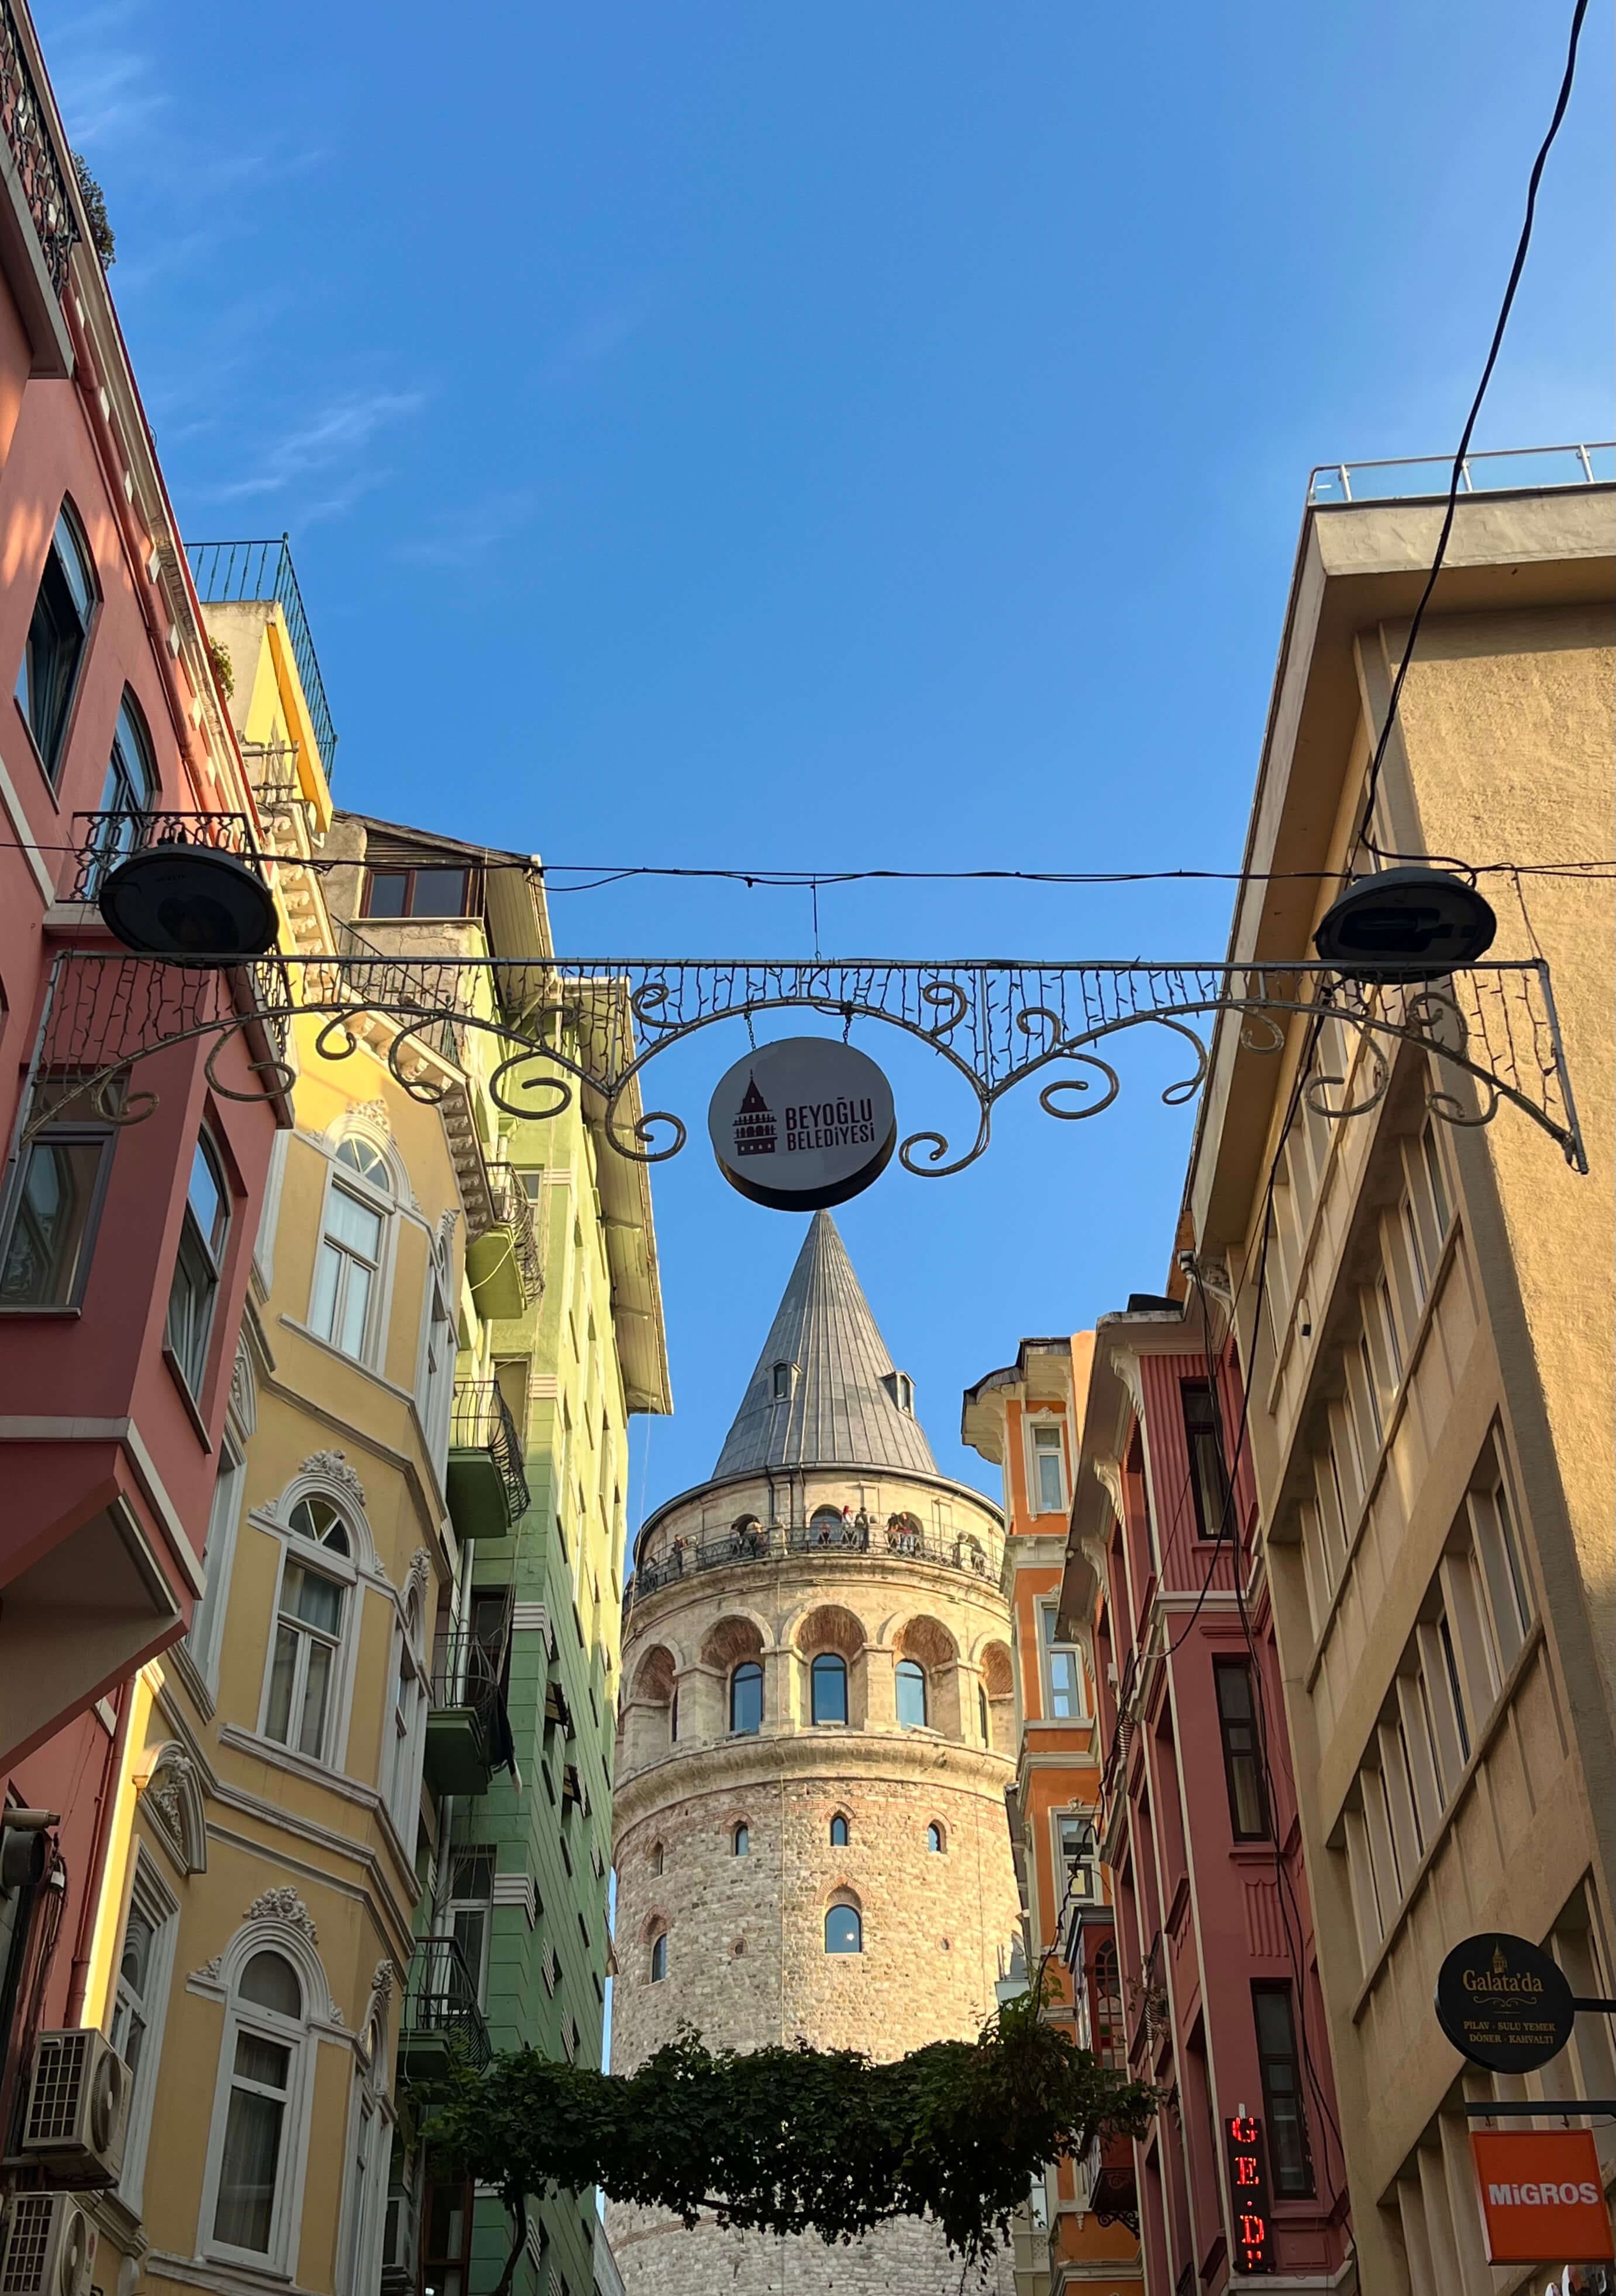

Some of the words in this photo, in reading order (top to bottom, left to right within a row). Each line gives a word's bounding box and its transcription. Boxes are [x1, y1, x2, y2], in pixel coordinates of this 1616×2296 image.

[785, 1097, 873, 1131] BEYOĞLU
[1463, 1969, 1545, 1992] Galata'da
[1497, 2022, 1521, 2031] SULU
[1523, 2022, 1556, 2032] YEMEK
[1469, 2032, 1502, 2043] DÖNER
[1509, 2035, 1553, 2045] KAHVALTI
